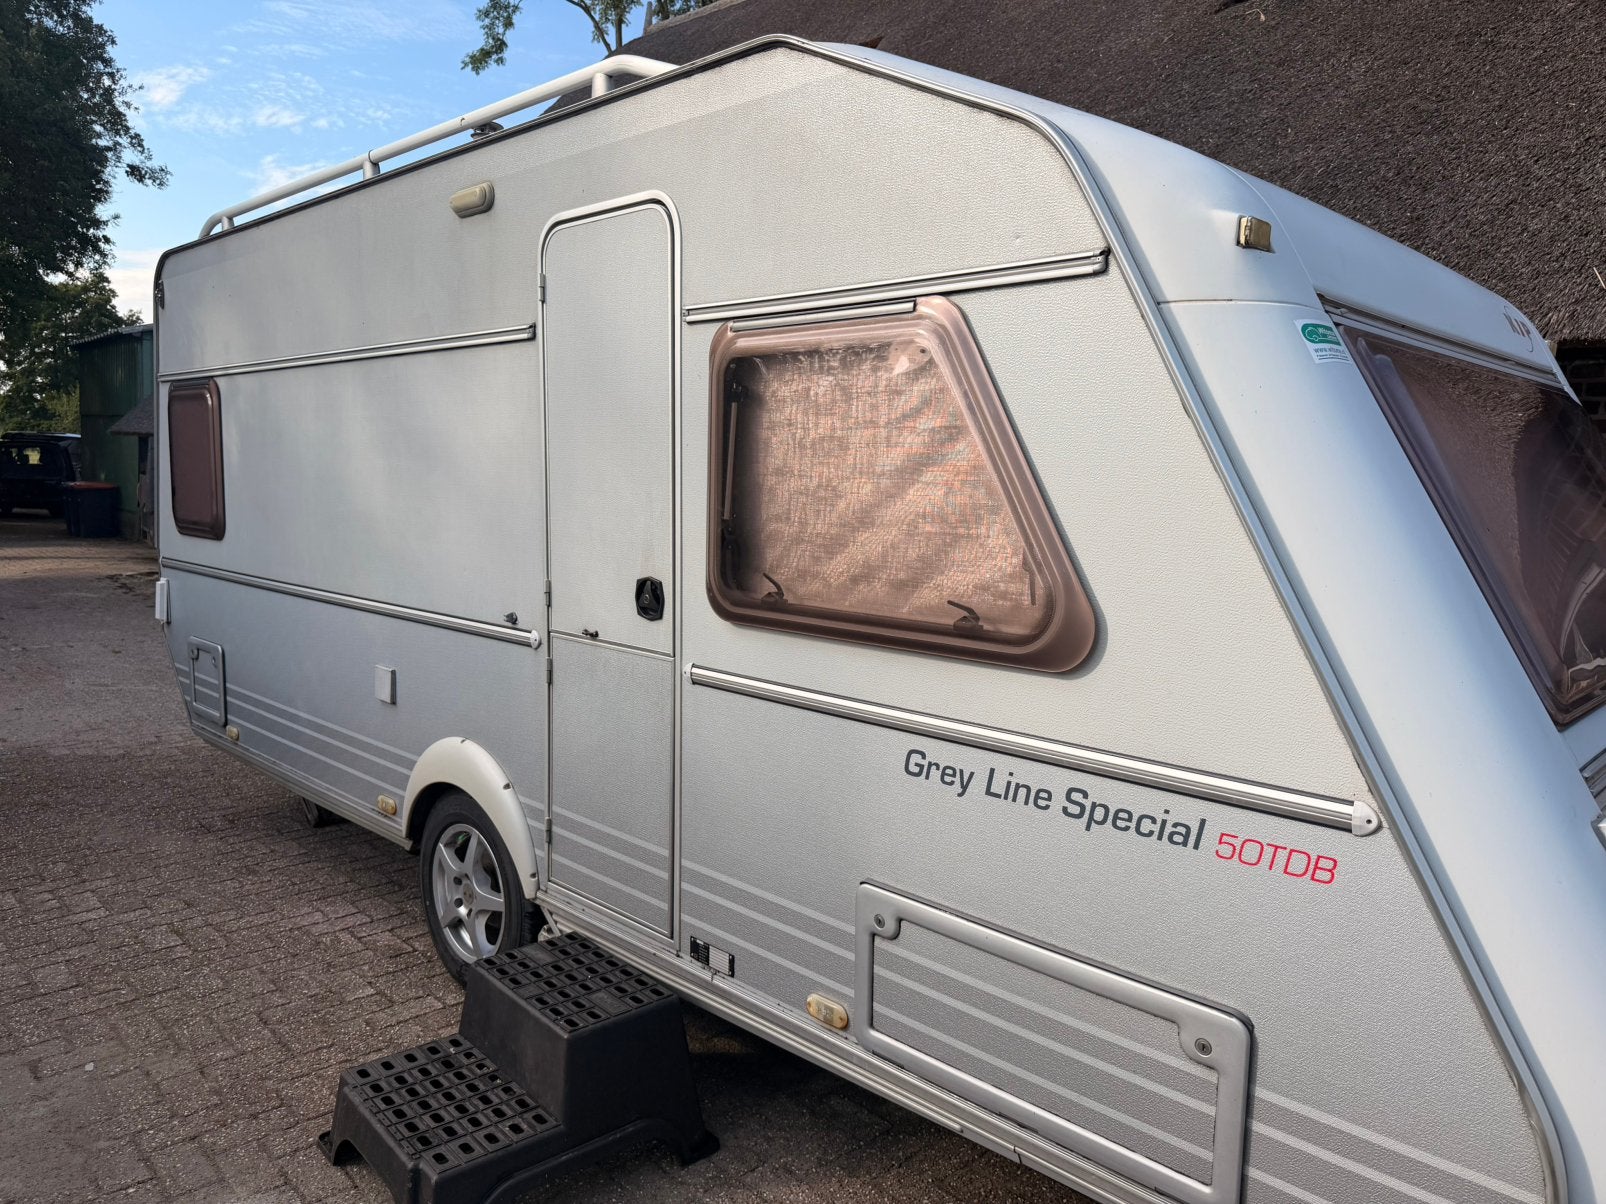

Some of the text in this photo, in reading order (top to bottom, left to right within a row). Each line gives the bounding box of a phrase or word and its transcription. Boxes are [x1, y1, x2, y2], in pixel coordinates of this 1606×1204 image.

[904, 748, 1339, 886] Grey Line Special 50TDB
